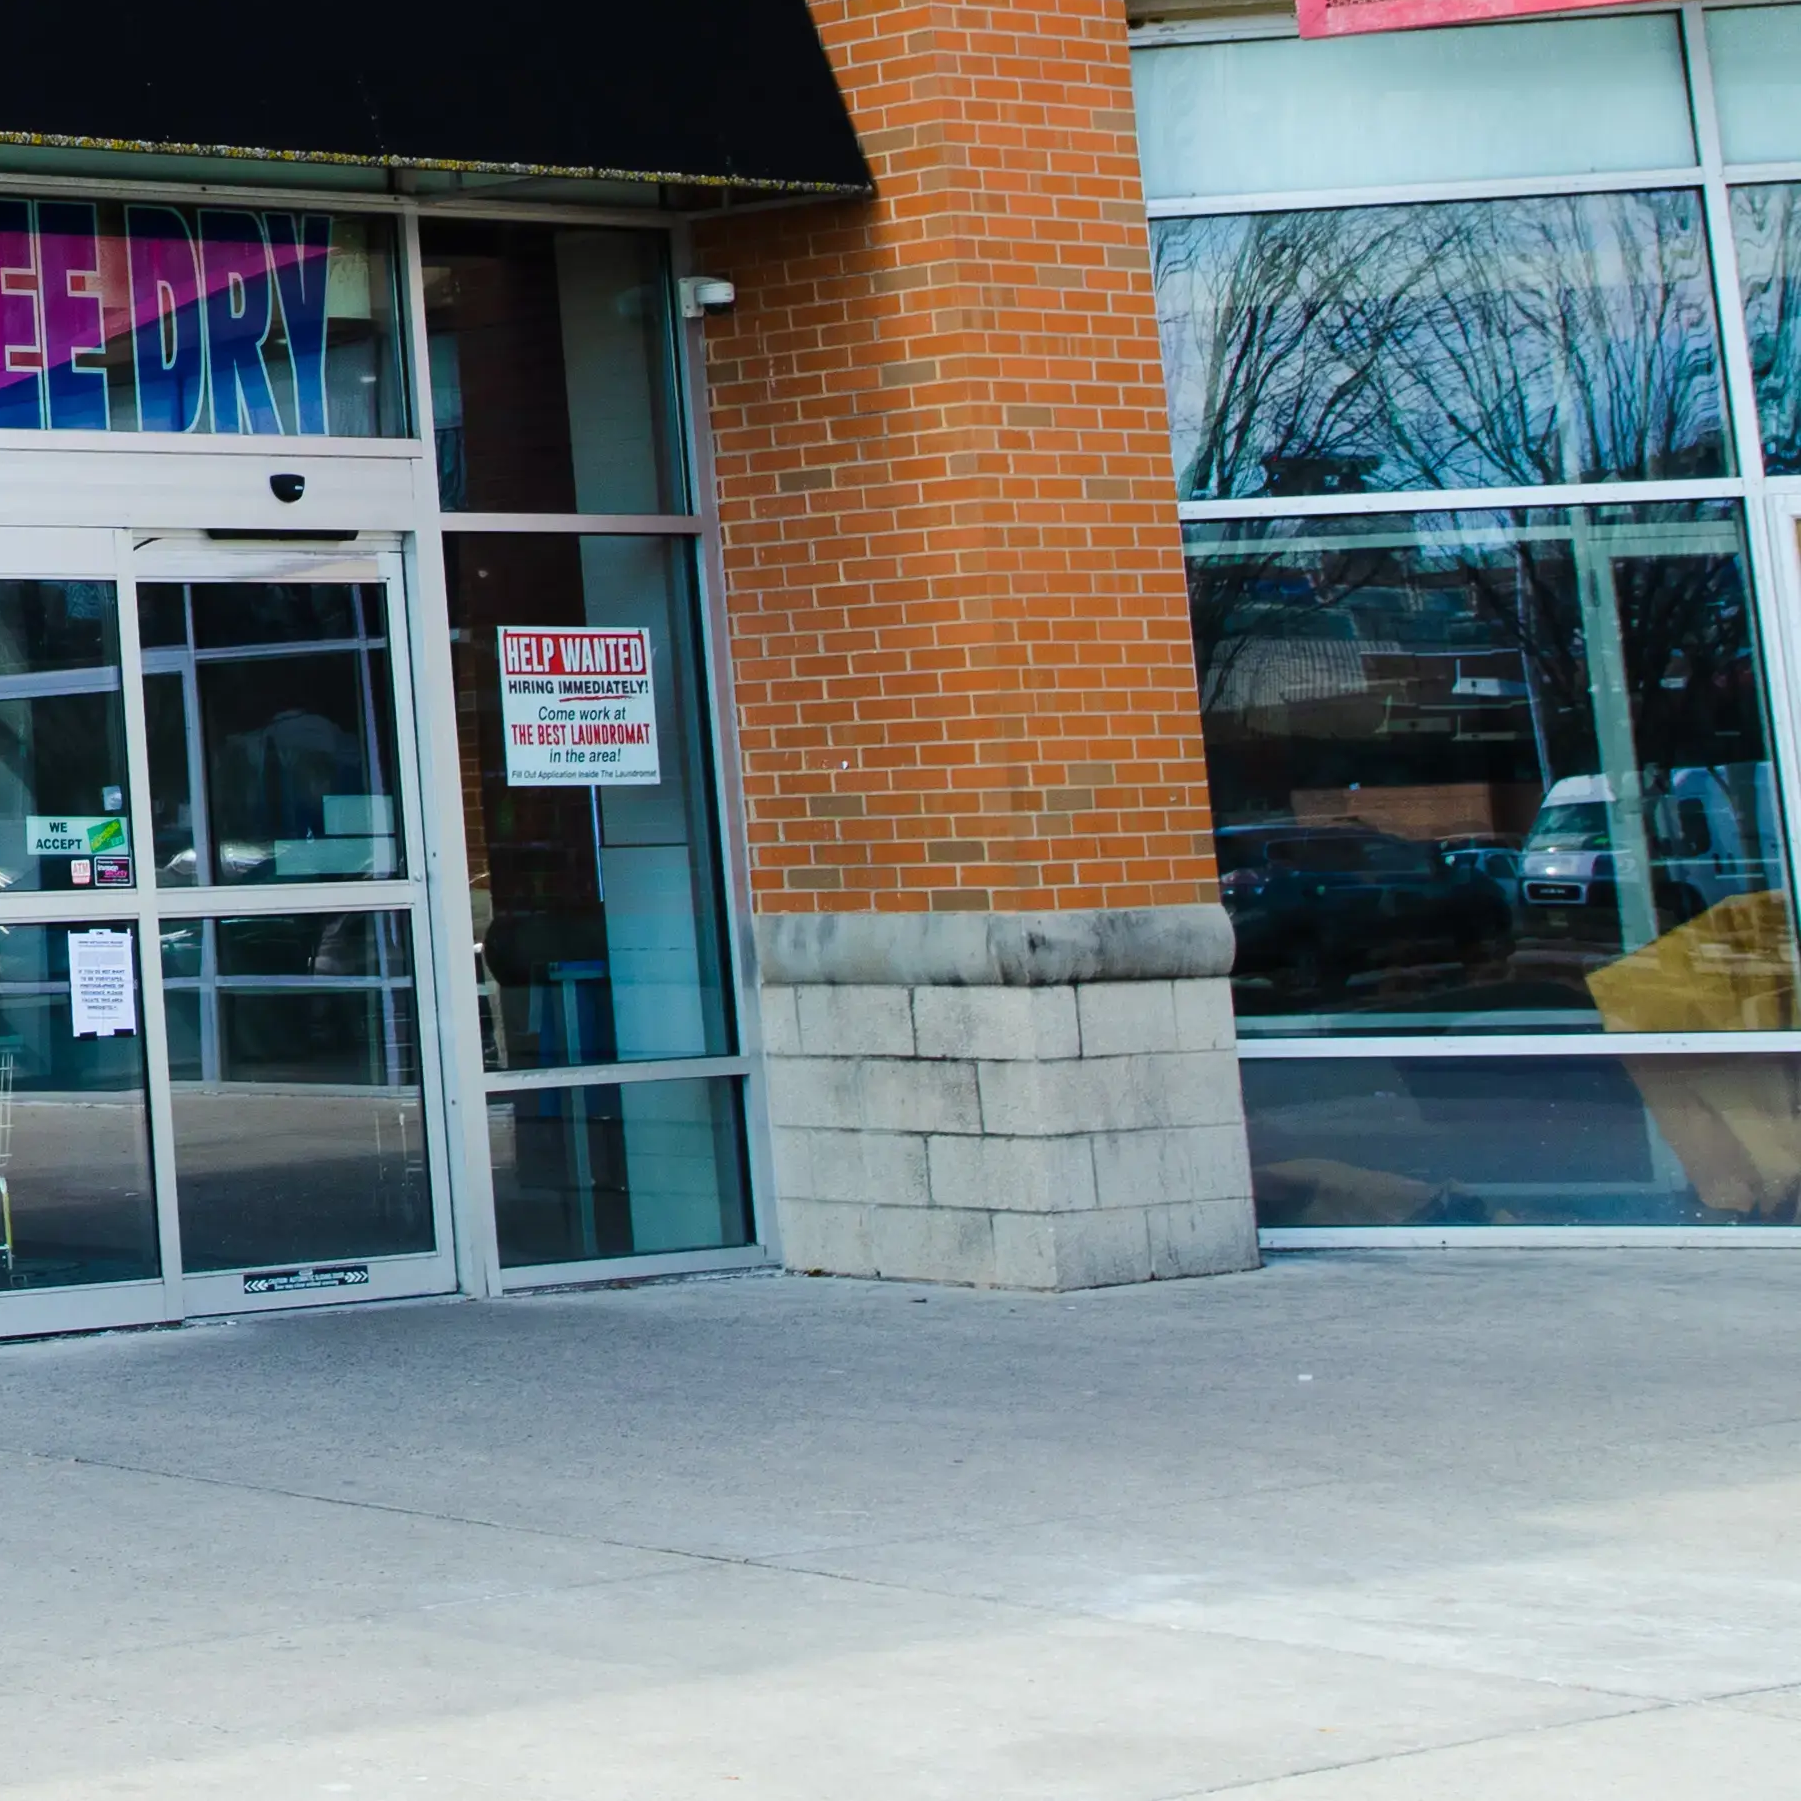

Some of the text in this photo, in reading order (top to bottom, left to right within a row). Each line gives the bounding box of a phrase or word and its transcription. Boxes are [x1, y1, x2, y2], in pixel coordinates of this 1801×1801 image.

[124, 204, 334, 436] DRY
[505, 636, 644, 673] HELP WANTED
[508, 680, 649, 694] HIRING IMMEDIATELY!
[538, 706, 626, 721] Come work at
[511, 723, 651, 745] THE BEST LAUNDROMAT
[549, 748, 621, 763] in the area!
[537, 770, 577, 780] Application
[600, 770, 613, 778] The
[49, 822, 68, 833] WE
[35, 838, 83, 850] ACCEPT
